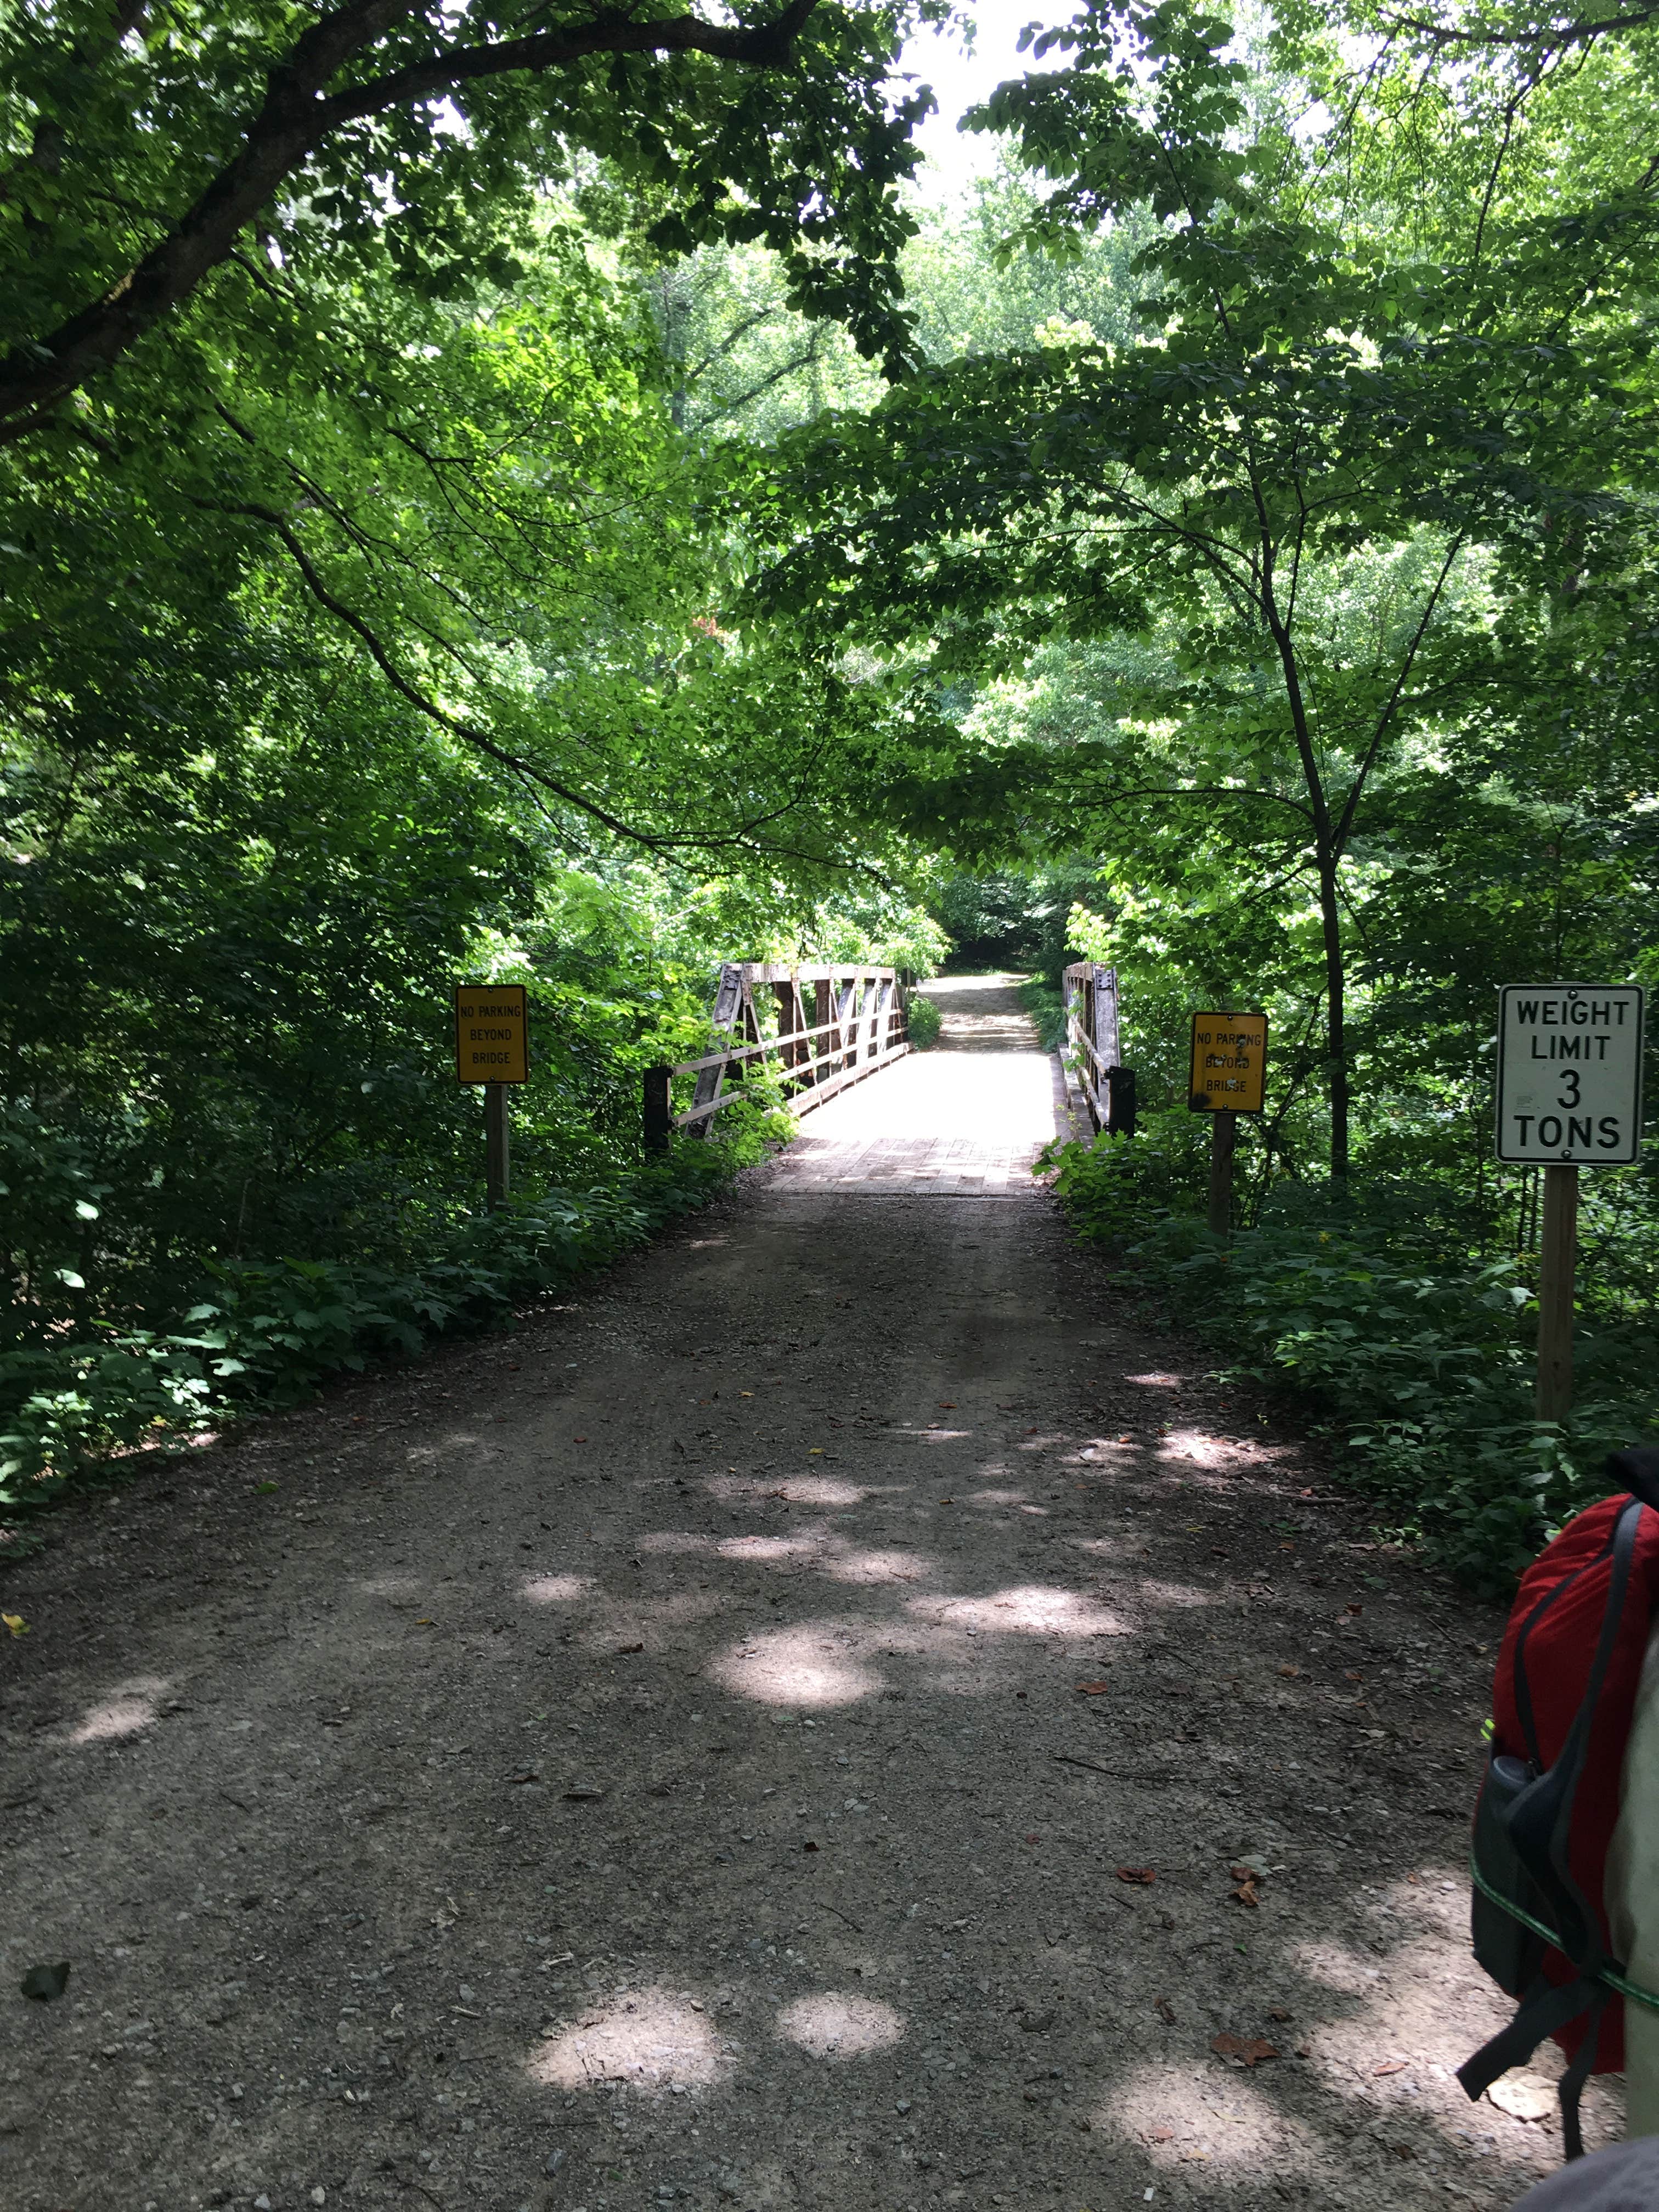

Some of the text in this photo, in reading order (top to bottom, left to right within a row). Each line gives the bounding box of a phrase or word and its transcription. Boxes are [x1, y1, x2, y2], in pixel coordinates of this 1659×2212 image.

[460, 1005, 521, 1017] NO PARKING
[1516, 1001, 1630, 1025] WEIGHT
[470, 1029, 512, 1041] BEYOND
[1197, 1032, 1261, 1046] NO PARNG
[1531, 1035, 1611, 1060] LIMIT
[472, 1052, 510, 1064] BRIDGE
[1557, 1069, 1581, 1109] 3
[1513, 1115, 1620, 1149] TONS
